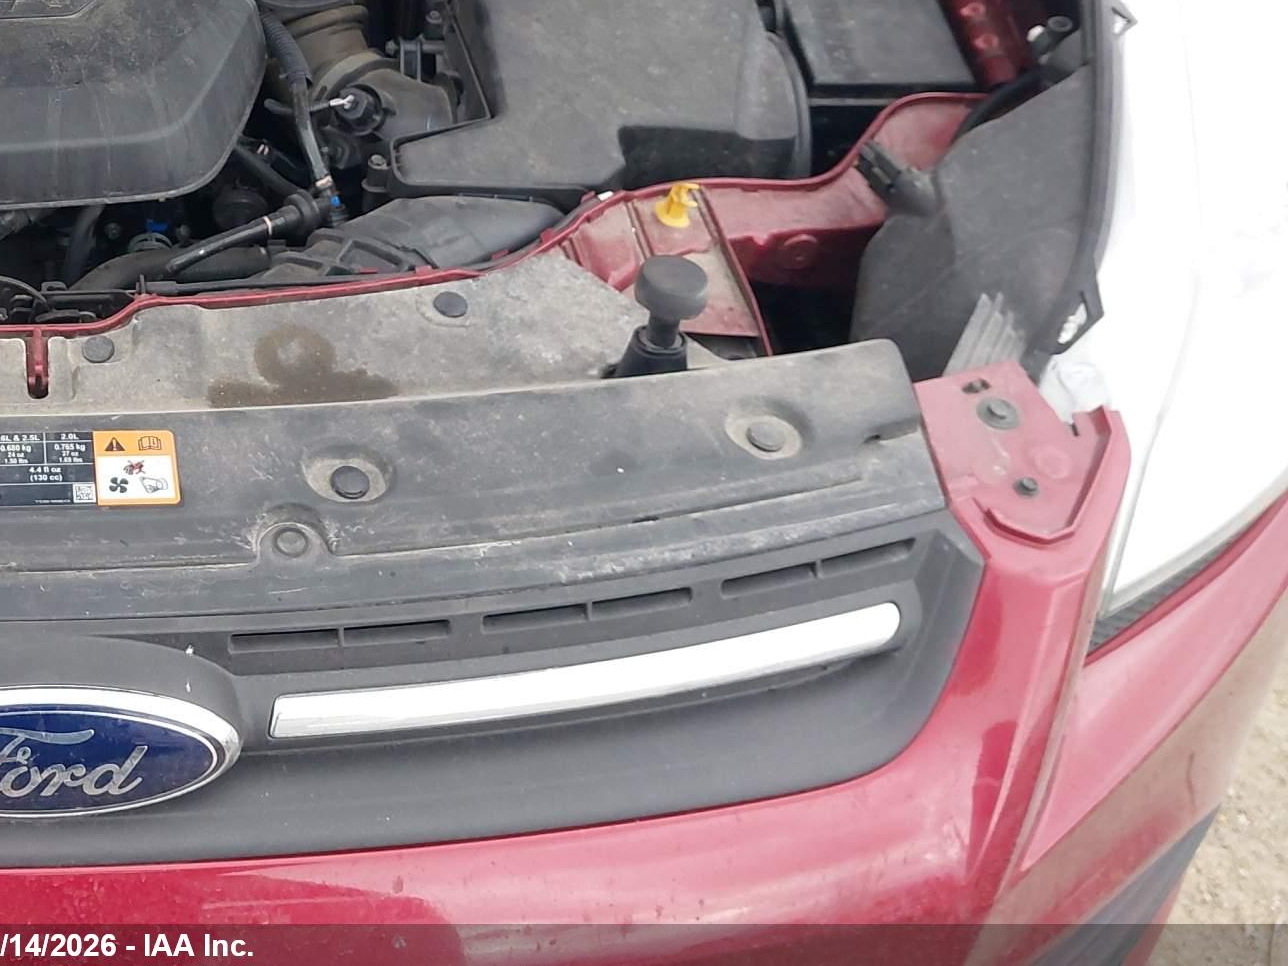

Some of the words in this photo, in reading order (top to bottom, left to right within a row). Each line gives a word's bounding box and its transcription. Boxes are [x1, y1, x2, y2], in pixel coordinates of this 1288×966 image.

[13, 434, 20, 442] &
[21, 444, 32, 453] kg
[75, 443, 86, 452] kg
[29, 474, 48, 482] (130
[49, 474, 63, 482] cc)
